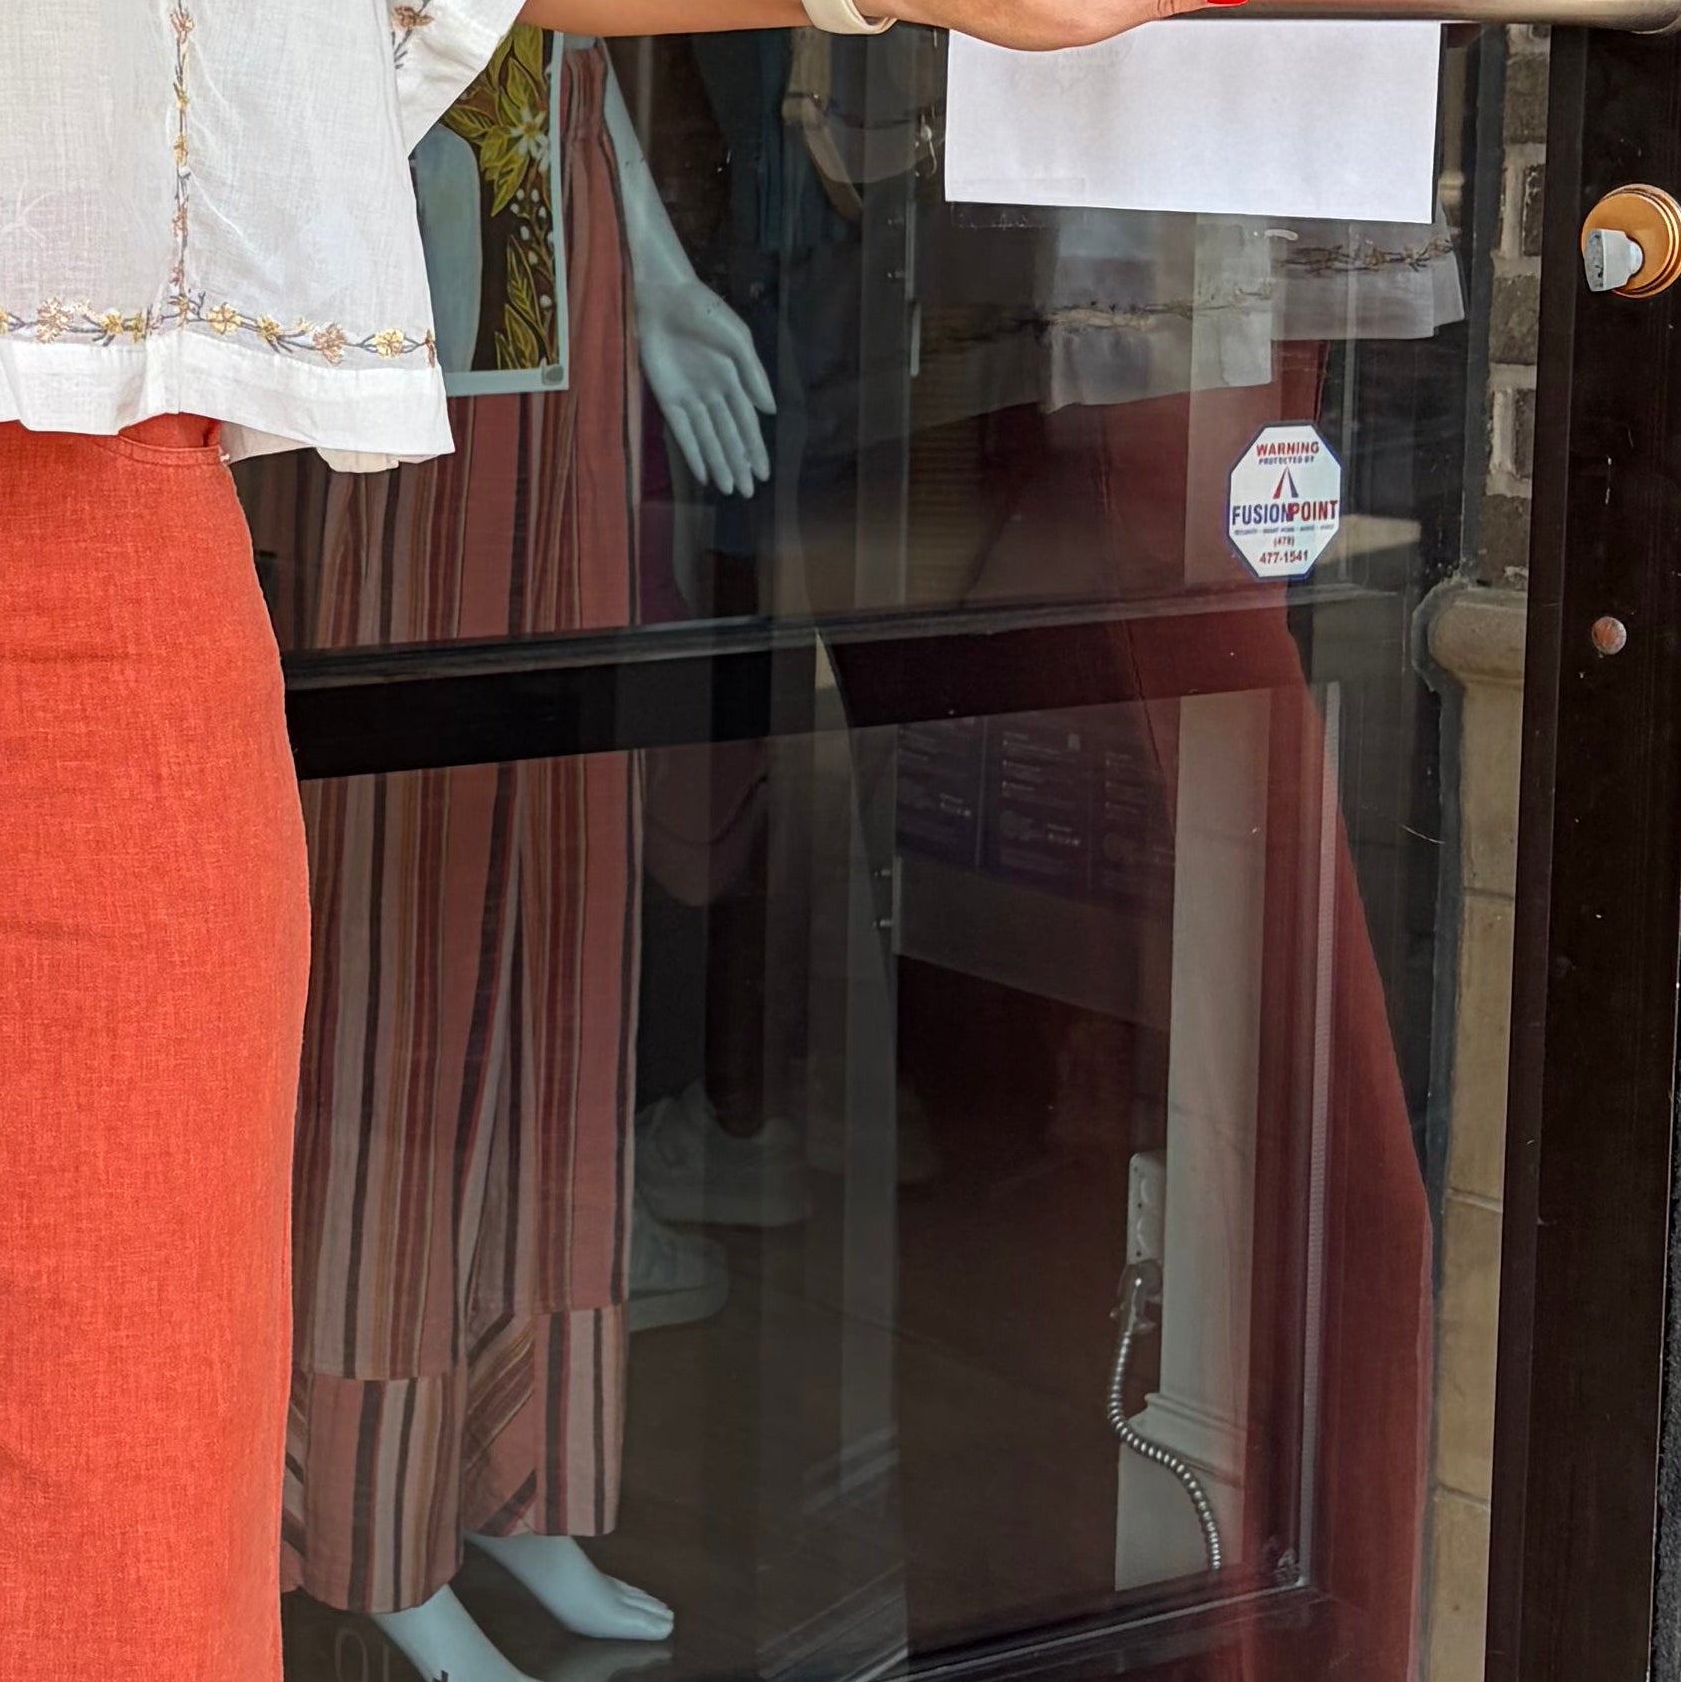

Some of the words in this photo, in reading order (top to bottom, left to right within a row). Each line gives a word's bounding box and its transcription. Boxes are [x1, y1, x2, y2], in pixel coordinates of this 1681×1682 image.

[1256, 441, 1320, 457] WARNING
[1232, 500, 1338, 526] FUSIONPOINT
[1259, 549, 1308, 565] 477-1541
